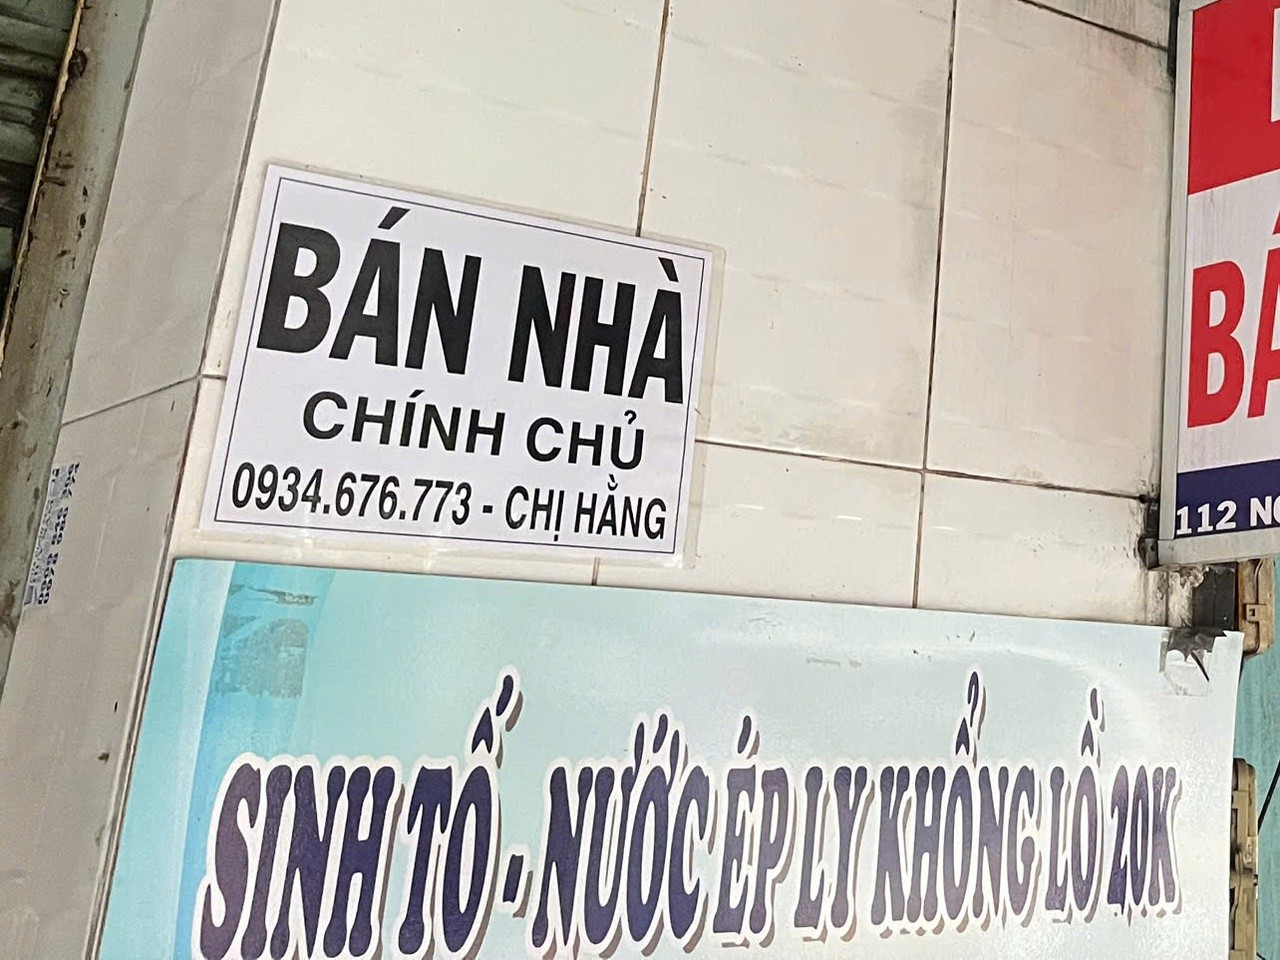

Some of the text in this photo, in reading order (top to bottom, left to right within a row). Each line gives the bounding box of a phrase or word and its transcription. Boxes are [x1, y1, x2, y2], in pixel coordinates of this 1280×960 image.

[257, 206, 683, 404] BÁN NHÀ
[302, 389, 645, 470] CHÍNH CHỦ
[231, 461, 471, 526] 0934.676.773
[505, 485, 566, 541] CHỊ
[573, 474, 667, 540] HẰNG
[1176, 500, 1236, 536] 112
[198, 760, 397, 960] SINH
[398, 673, 515, 956] TỐ
[531, 712, 711, 949] NƯỚC
[712, 714, 790, 935] ÉP
[794, 765, 869, 930] LY
[870, 670, 1036, 922] KHỔNG
[1044, 686, 1099, 913] LỒ
[1106, 764, 1178, 916] 20K
